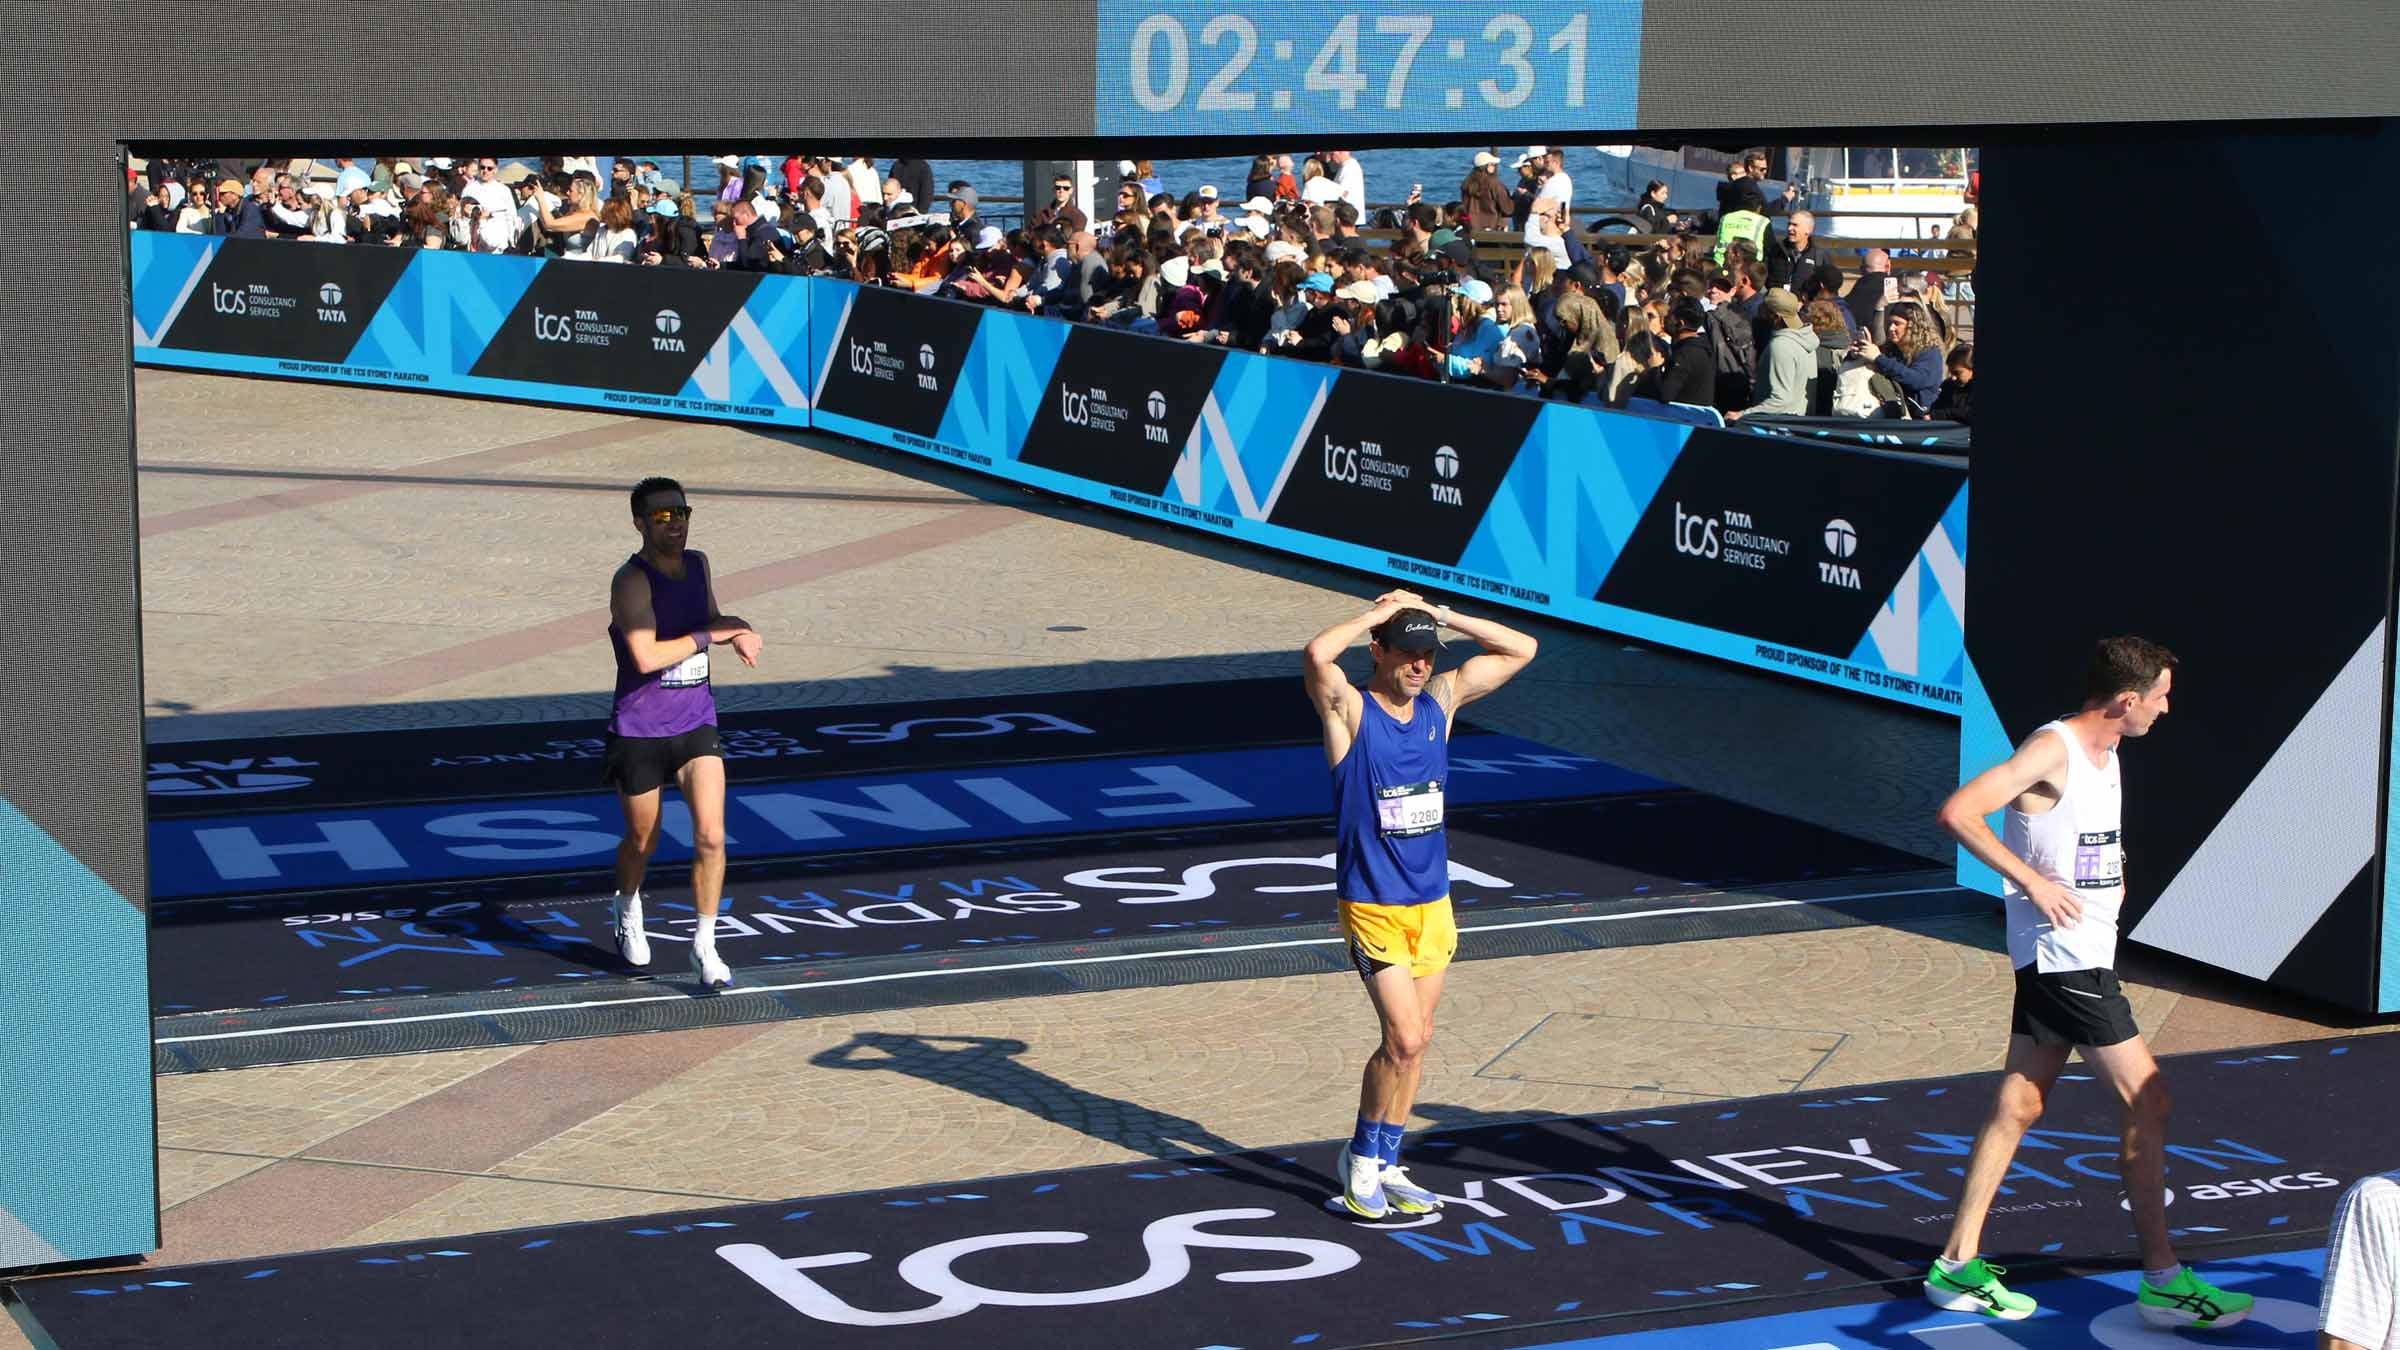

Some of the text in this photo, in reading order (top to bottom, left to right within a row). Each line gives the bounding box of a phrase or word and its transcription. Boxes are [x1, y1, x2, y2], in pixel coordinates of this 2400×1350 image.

[1130, 13, 1591, 112] 02:47:31
[212, 282, 246, 315] tcs
[249, 284, 269, 295] TATA
[249, 296, 297, 308] CONSULTANCY
[249, 306, 280, 318] SERVICES
[317, 308, 347, 323] TATA
[534, 306, 570, 342] tcs
[575, 310, 598, 321] TATA
[575, 322, 628, 337] CONSULTANCY
[575, 335, 609, 346] SERVICES
[652, 337, 685, 352] TATA
[873, 341, 887, 352] TATA
[850, 336, 873, 376] tcs
[918, 373, 938, 391] TATA
[1062, 382, 1088, 427] tcs
[1090, 387, 1107, 401] TATA
[1090, 401, 1128, 422] CONSULTANCY
[1090, 416, 1115, 432] SERVICES
[1144, 424, 1169, 444] TATA
[1360, 440, 1382, 456] TATA
[1324, 434, 1357, 484] tcs
[1360, 457, 1410, 479] CONSULTANCY
[1360, 473, 1392, 491] SERVICES
[1431, 483, 1462, 506] TATA
[1675, 501, 1719, 559] tcs
[1724, 510, 1752, 529] TATA
[1724, 530, 1790, 557] CONSULTANCY
[1723, 548, 1766, 570] SERVICES
[1387, 557, 1550, 605] PROUD SPONSOR OF THE TCS SYDNEY MARATHON
[1818, 562, 1861, 590] TATA
[1755, 644, 1963, 706] PROUD SPONSOR OF THE TCS SYDNEY MARATH
[816, 712, 1096, 744] tcs
[146, 756, 320, 774] TAT
[194, 765, 1255, 880] FINISH
[1411, 809, 1438, 824] 2280
[2186, 1171, 2340, 1200] asics
[1913, 1197, 2083, 1225] prented by
[715, 1208, 1361, 1326] tcs
